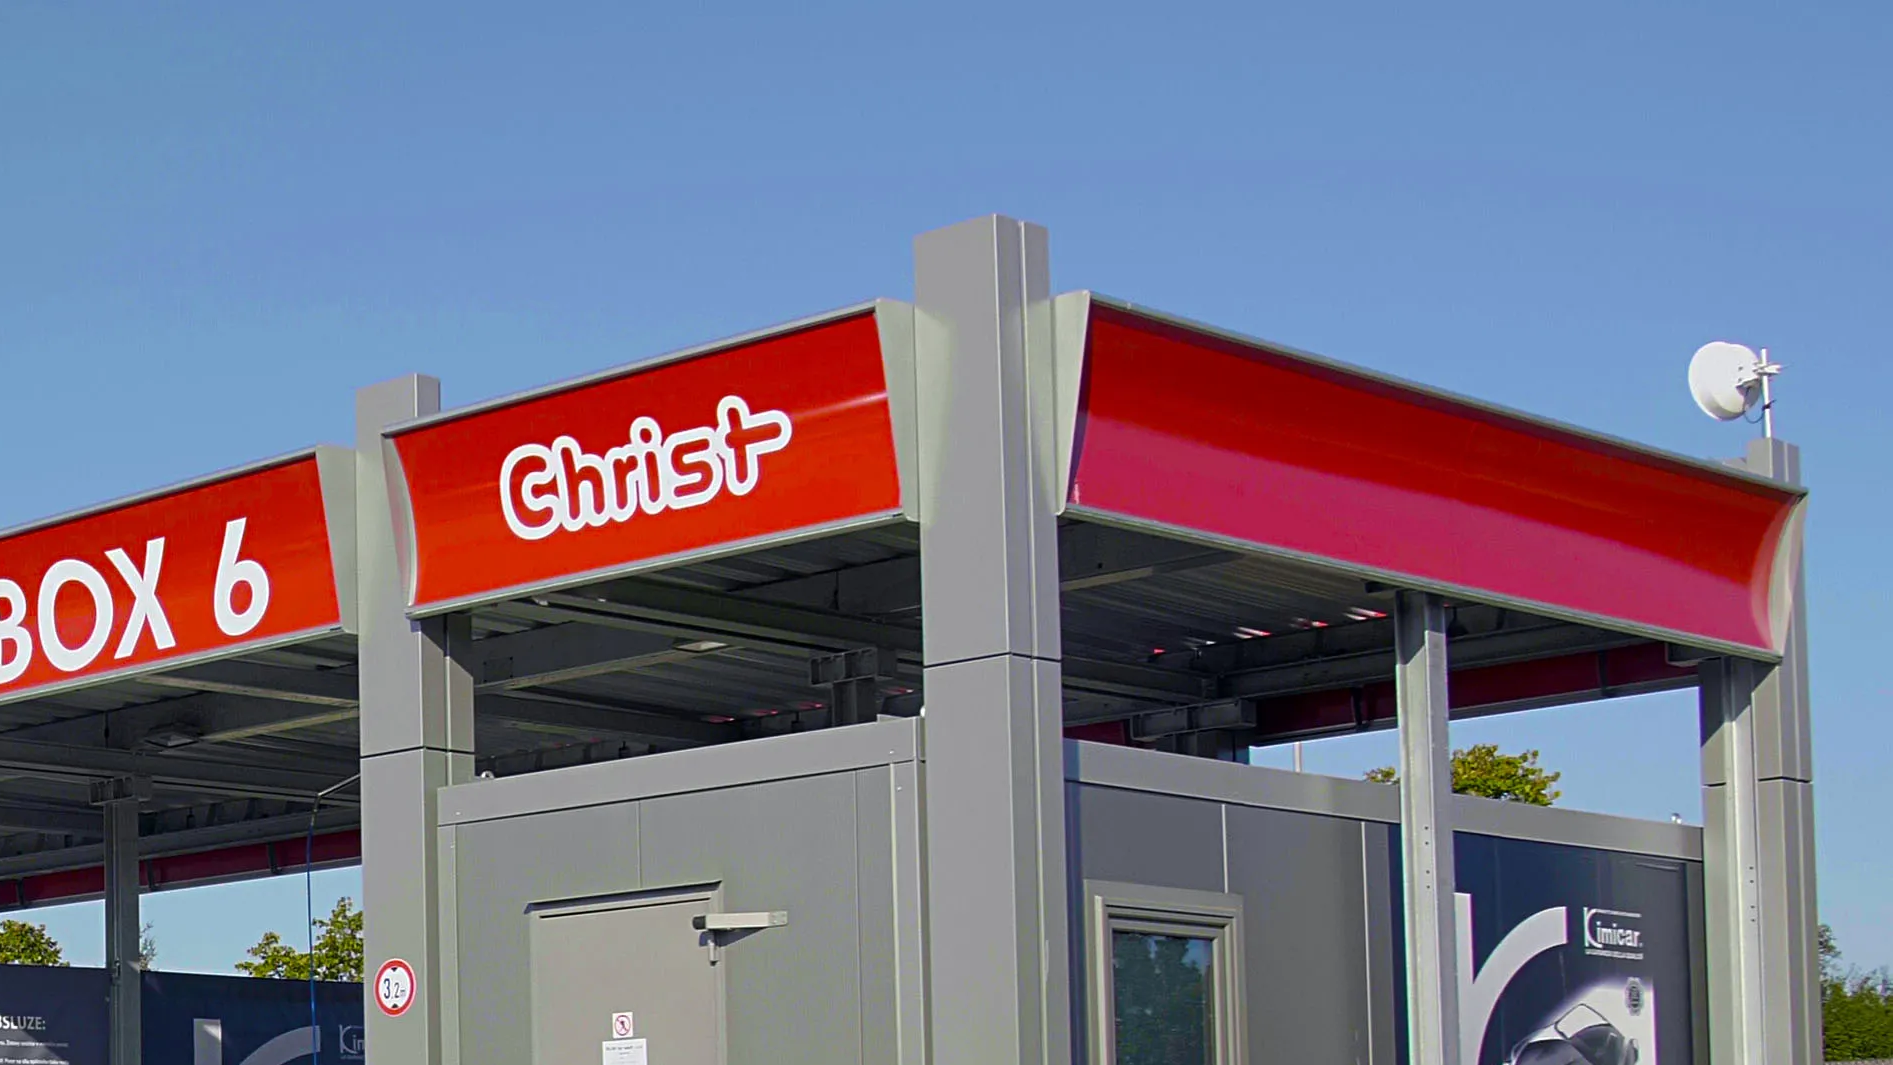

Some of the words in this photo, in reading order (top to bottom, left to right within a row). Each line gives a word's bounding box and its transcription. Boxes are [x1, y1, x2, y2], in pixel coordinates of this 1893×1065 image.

[500, 395, 792, 540] Christ
[213, 517, 269, 637] 6
[1583, 906, 1641, 948] Kimicar
